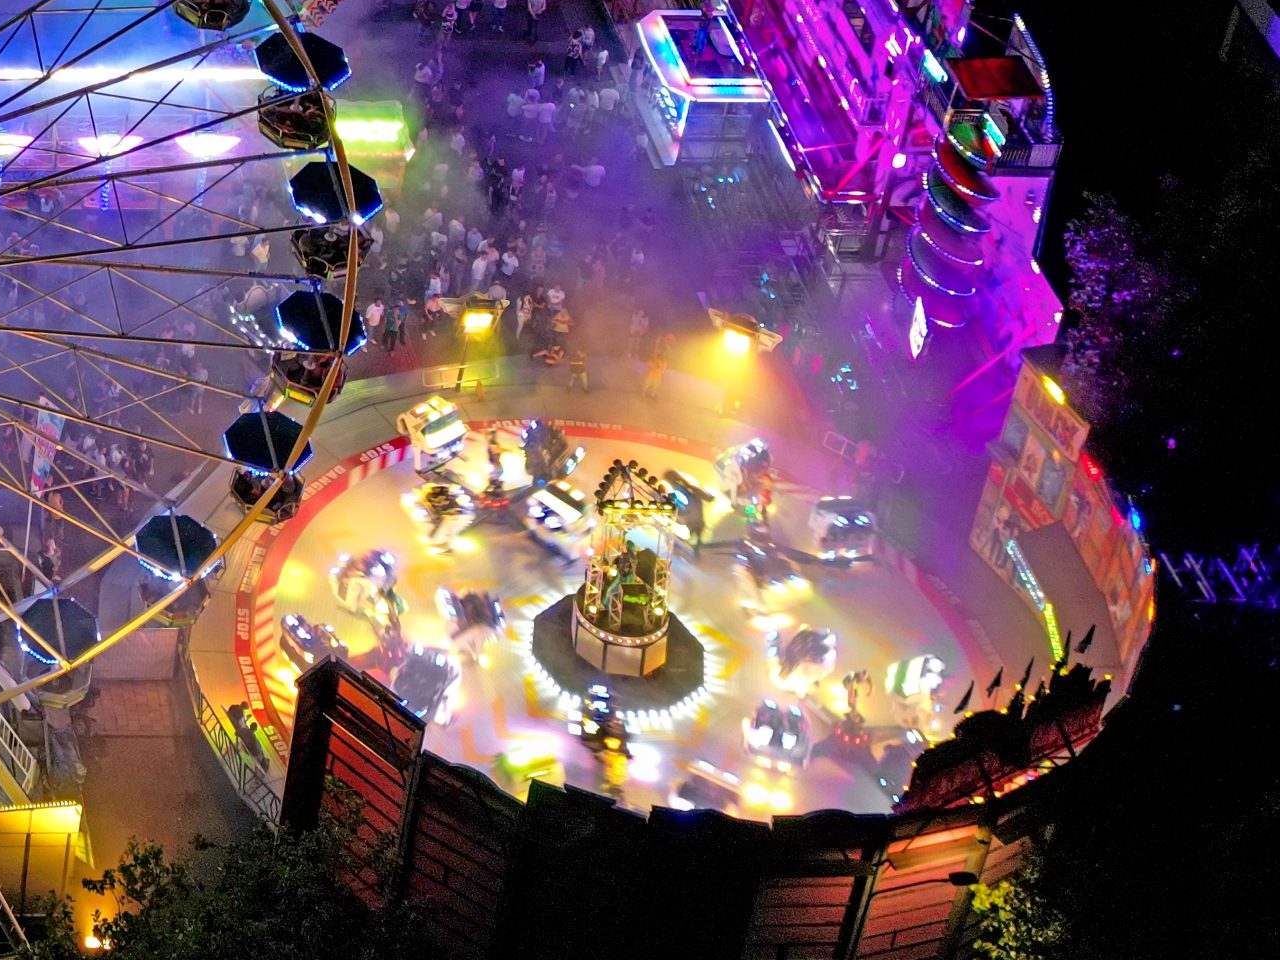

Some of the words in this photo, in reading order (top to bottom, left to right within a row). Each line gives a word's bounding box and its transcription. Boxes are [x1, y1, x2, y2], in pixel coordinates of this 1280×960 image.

[359, 442, 395, 463] STOP
[301, 464, 347, 501] DANGER
[236, 607, 250, 641] STOP
[238, 655, 265, 711] DANGER
